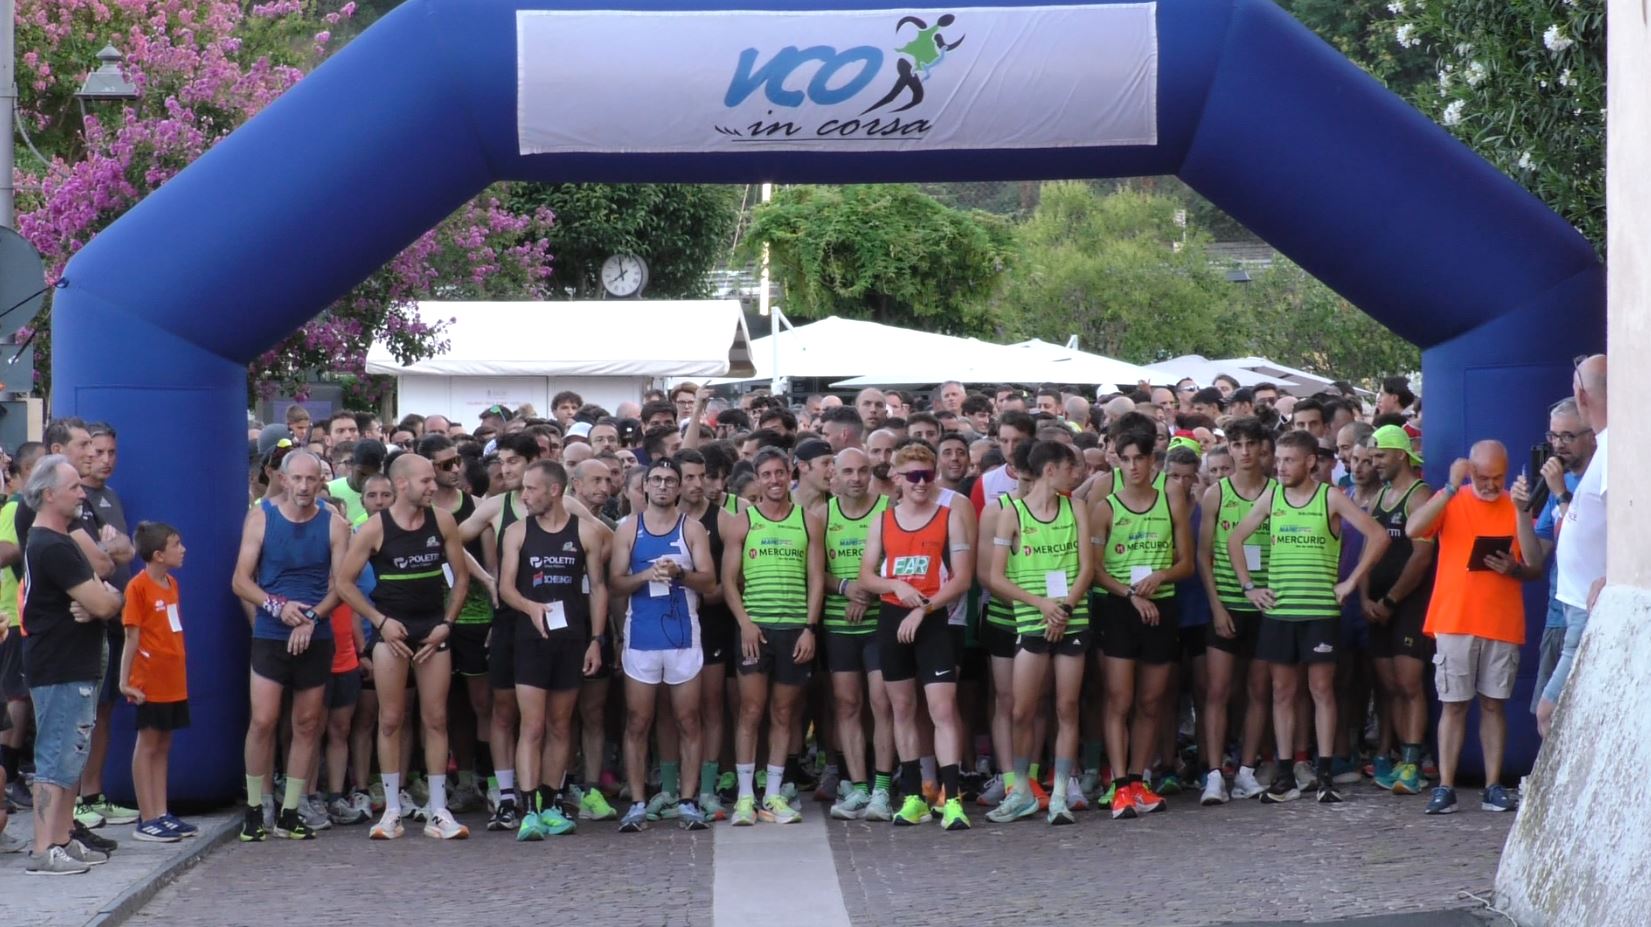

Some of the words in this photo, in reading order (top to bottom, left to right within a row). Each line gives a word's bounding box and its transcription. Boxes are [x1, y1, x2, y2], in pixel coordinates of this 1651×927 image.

[724, 45, 884, 107] VCO
[816, 117, 932, 136] corsa
[1277, 535, 1326, 545] MERCURIO
[543, 556, 575, 565] POLETTI
